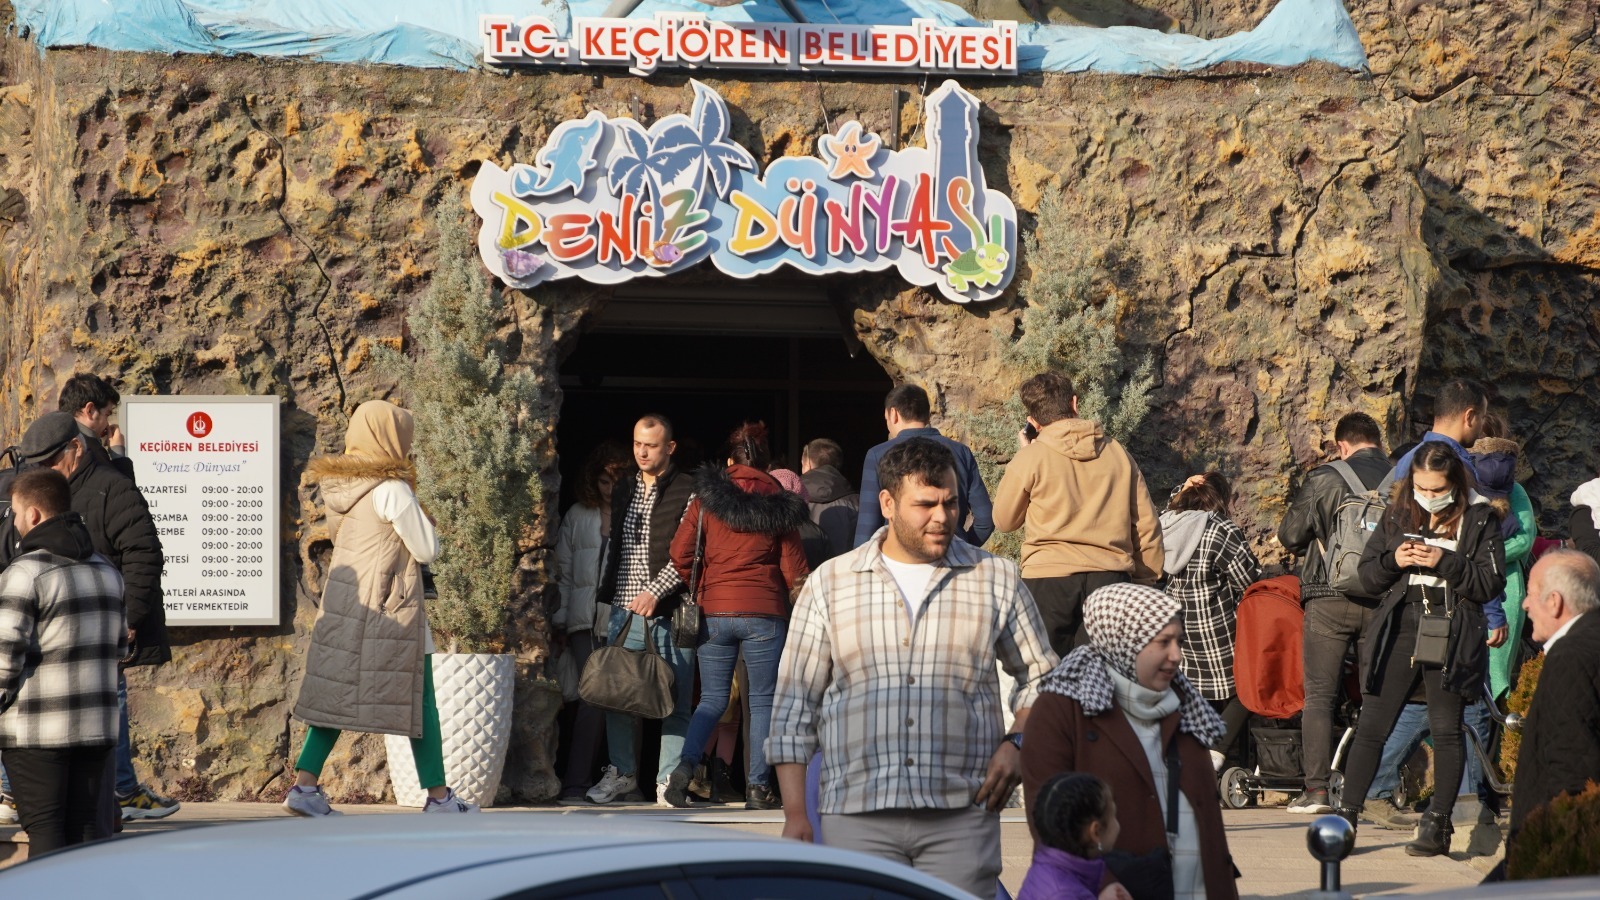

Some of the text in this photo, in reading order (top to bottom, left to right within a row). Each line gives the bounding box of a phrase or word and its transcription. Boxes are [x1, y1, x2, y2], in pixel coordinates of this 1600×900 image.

[491, 17, 1012, 66] T.C. KEÇİÖREN BELEDİYESİ
[140, 440, 259, 453] KEÇİÖREN BELEDİYESİ
[202, 485, 229, 494] 09:00
[236, 485, 264, 494] 20:00
[202, 499, 229, 508] 09:00
[236, 499, 263, 508] 20:00
[202, 513, 229, 522] 09:00
[236, 513, 263, 522] 20:00
[202, 527, 229, 536] 09:00
[236, 527, 263, 536] 20:00
[202, 541, 229, 550] 09:00
[236, 541, 263, 550] 20:00
[202, 555, 229, 564] 09:00
[236, 555, 263, 564] 20:00
[202, 569, 229, 578] 09:00
[236, 569, 263, 578] 20:00
[199, 588, 246, 597] ARASINDA
[186, 600, 249, 611] VERMEKTEDİR
